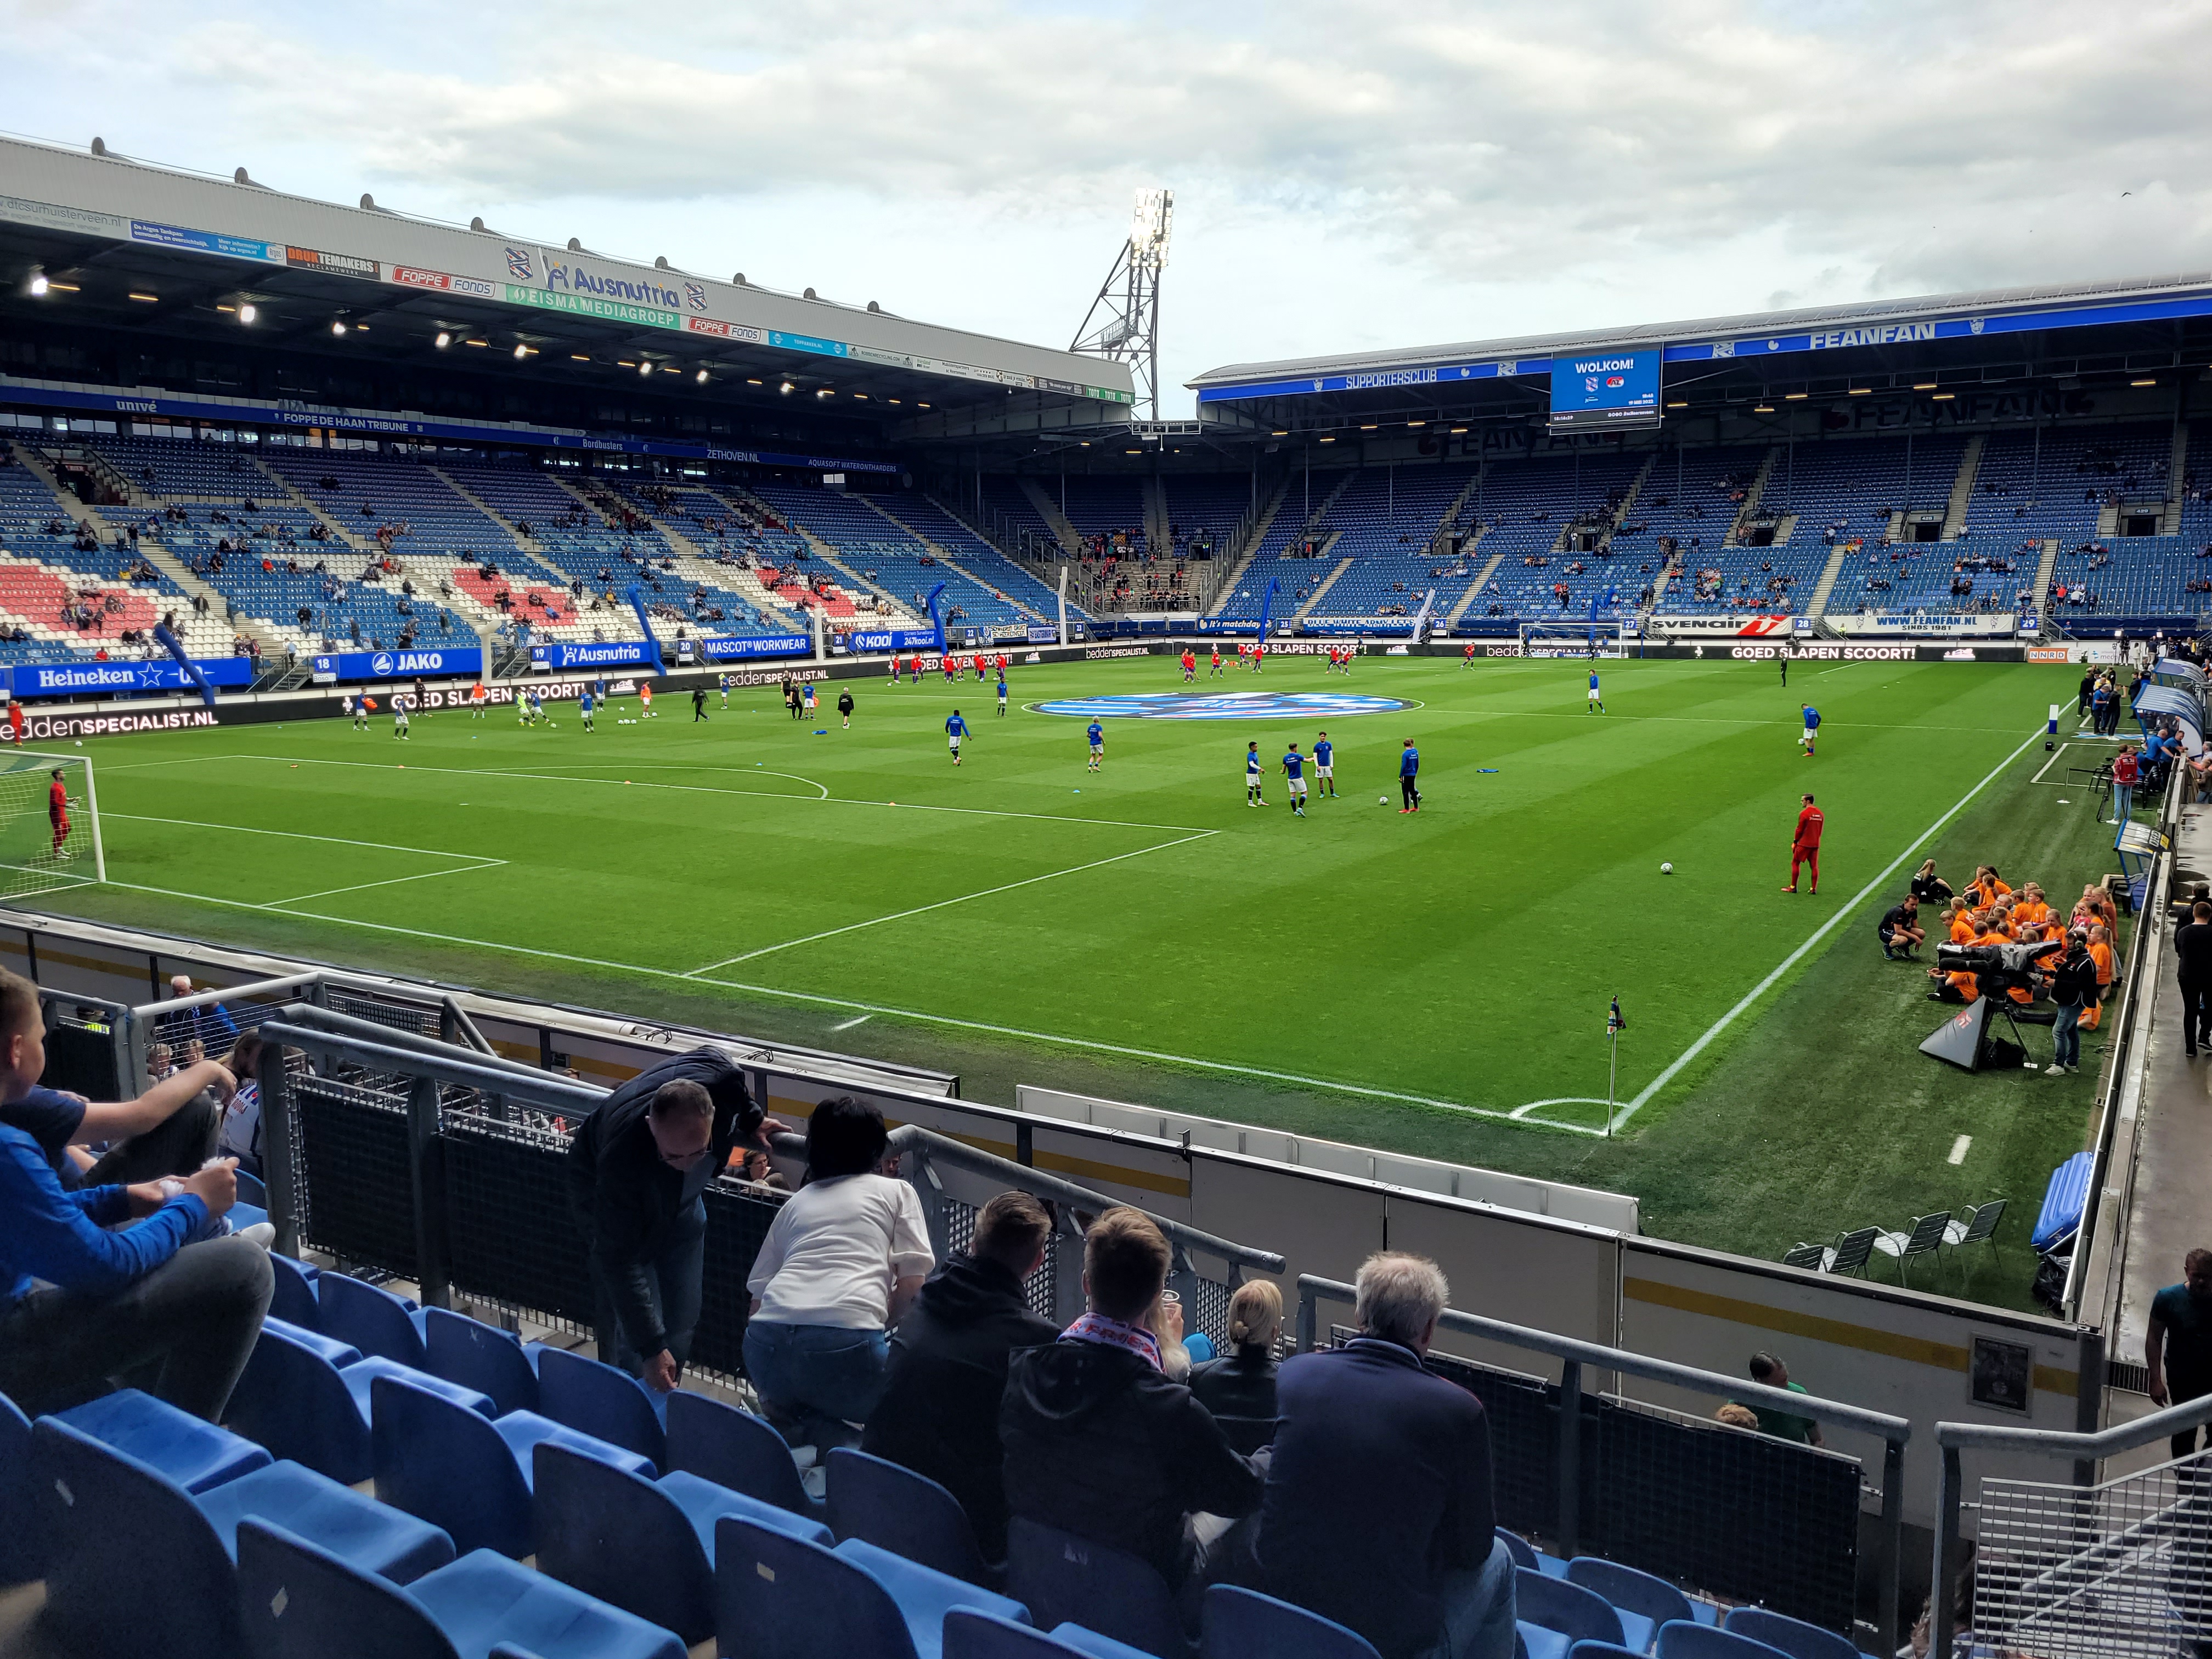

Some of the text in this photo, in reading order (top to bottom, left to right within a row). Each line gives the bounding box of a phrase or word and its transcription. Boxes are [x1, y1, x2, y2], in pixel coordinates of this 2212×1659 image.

[287, 247, 374, 273] DRUKTEMAKERS
[307, 263, 359, 275] RECLAMEWERK
[402, 270, 490, 295] FOPPE FONDS
[575, 268, 680, 308] Ausnutria
[528, 289, 674, 326] EISMA MEDIAGROEP
[695, 320, 758, 340] FOPPE FONDS
[1810, 323, 1936, 349] FEANFAN
[1575, 358, 1634, 374] WOLKOM!
[1346, 369, 1437, 390] SUPPORTERSCLUB
[1088, 388, 1099, 398] TOTO
[1105, 391, 1116, 400] TOTO
[1121, 393, 1131, 402] TOTO
[116, 400, 157, 413] univé
[284, 413, 409, 432] FOPPE DE HAAN TRIBUNE
[583, 438, 623, 450] Bordbusters
[707, 449, 759, 462] ZETHOVEN.NL
[808, 459, 896, 472] AQUASOFT WATERONTHARDERS
[1209, 620, 1261, 629] It's matchday
[1334, 619, 1362, 628] WHITE
[1364, 619, 1390, 628] ARMY,
[1798, 620, 1809, 628] 28
[1877, 616, 1978, 626] WWW.FEANFAN.NL
[2023, 620, 2035, 628] 29
[681, 642, 691, 651] 20
[753, 638, 806, 652] WORKWEAR
[836, 636, 842, 644] 21
[904, 637, 934, 646] 247kooi.nl
[535, 648, 545, 658] 19
[579, 645, 640, 662] Ausnutria
[1086, 647, 1149, 659] beddenSPECIALIST.NL
[1271, 644, 1315, 654] SLAPEN
[1317, 645, 1367, 654] SCOOR!
[1732, 646, 1916, 659] GOED SLAPEN SCOORT!
[317, 658, 330, 669] 18
[398, 653, 442, 670] JAKO
[921, 659, 939, 670] OED
[39, 668, 135, 687] Heineken
